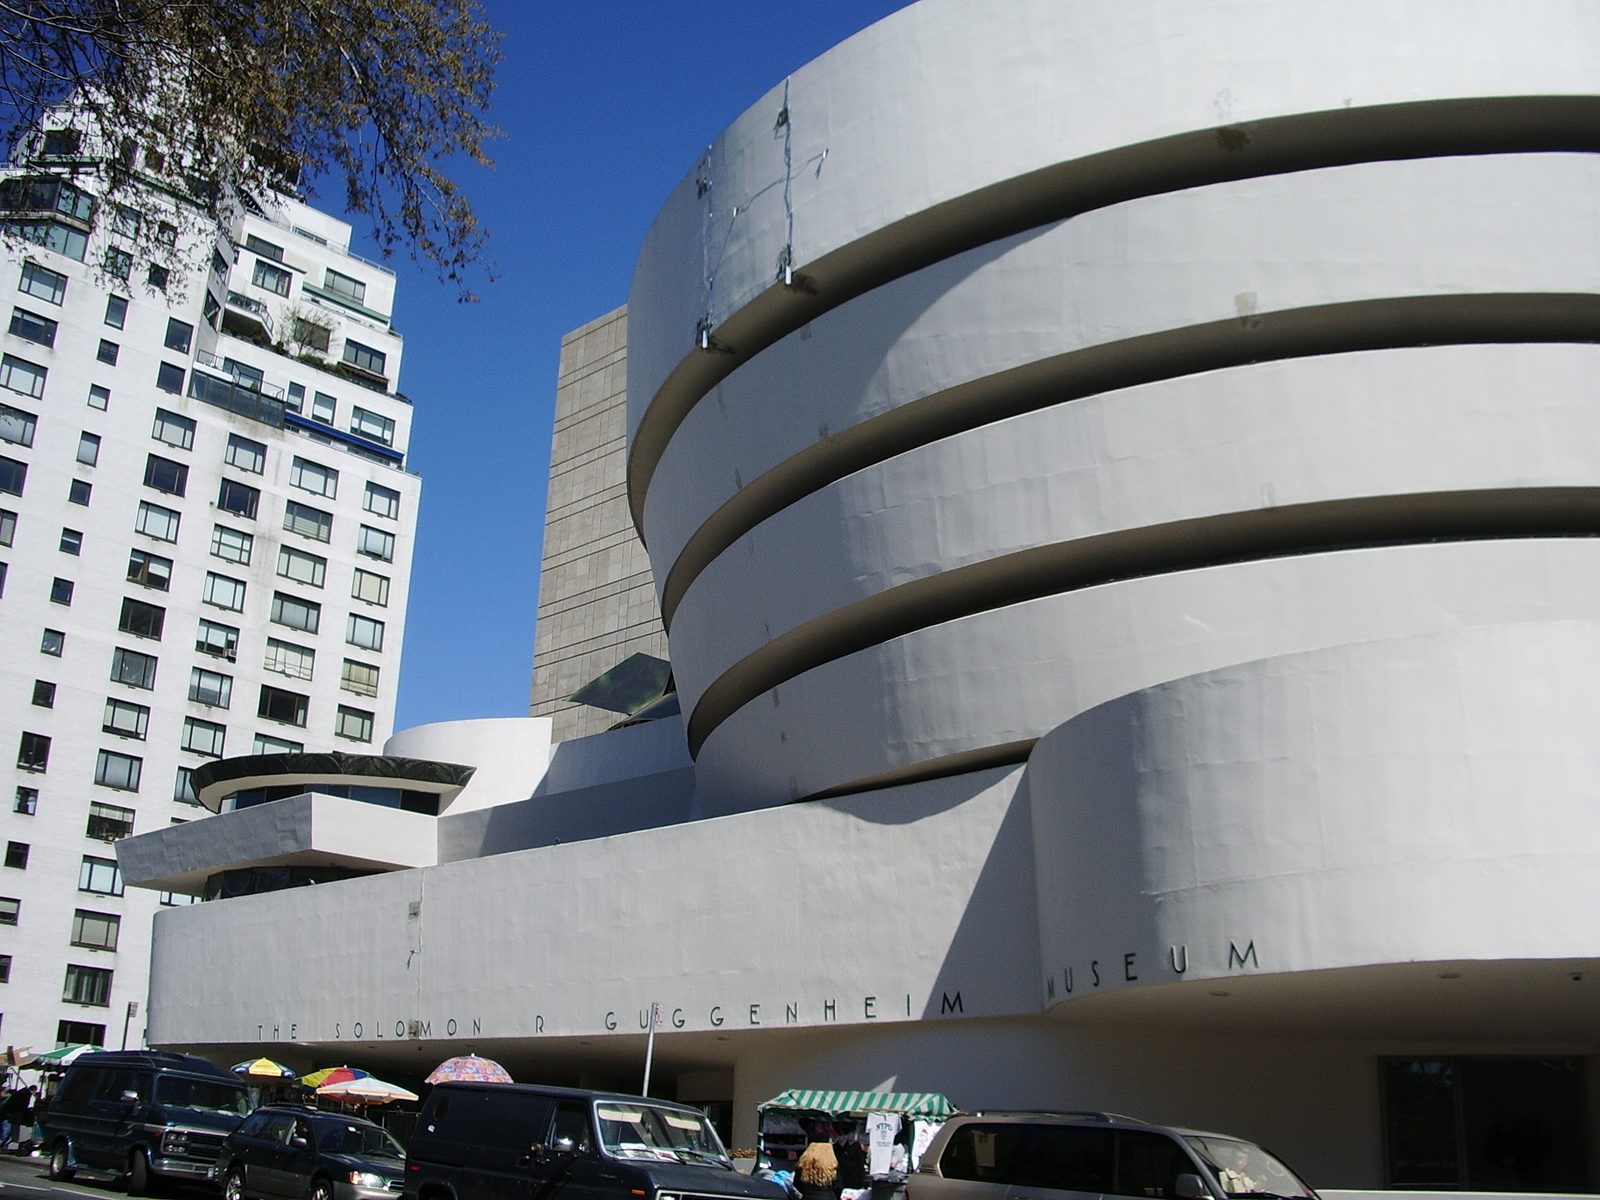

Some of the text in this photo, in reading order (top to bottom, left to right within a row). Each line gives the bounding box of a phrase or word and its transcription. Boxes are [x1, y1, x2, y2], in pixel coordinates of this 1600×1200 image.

[258, 1023, 297, 1041] THE
[335, 1018, 481, 1039] SOLOMON
[535, 1015, 544, 1033] R
[604, 991, 964, 1031] GUGGENHEIM
[1047, 939, 1259, 999] MUSEUM
